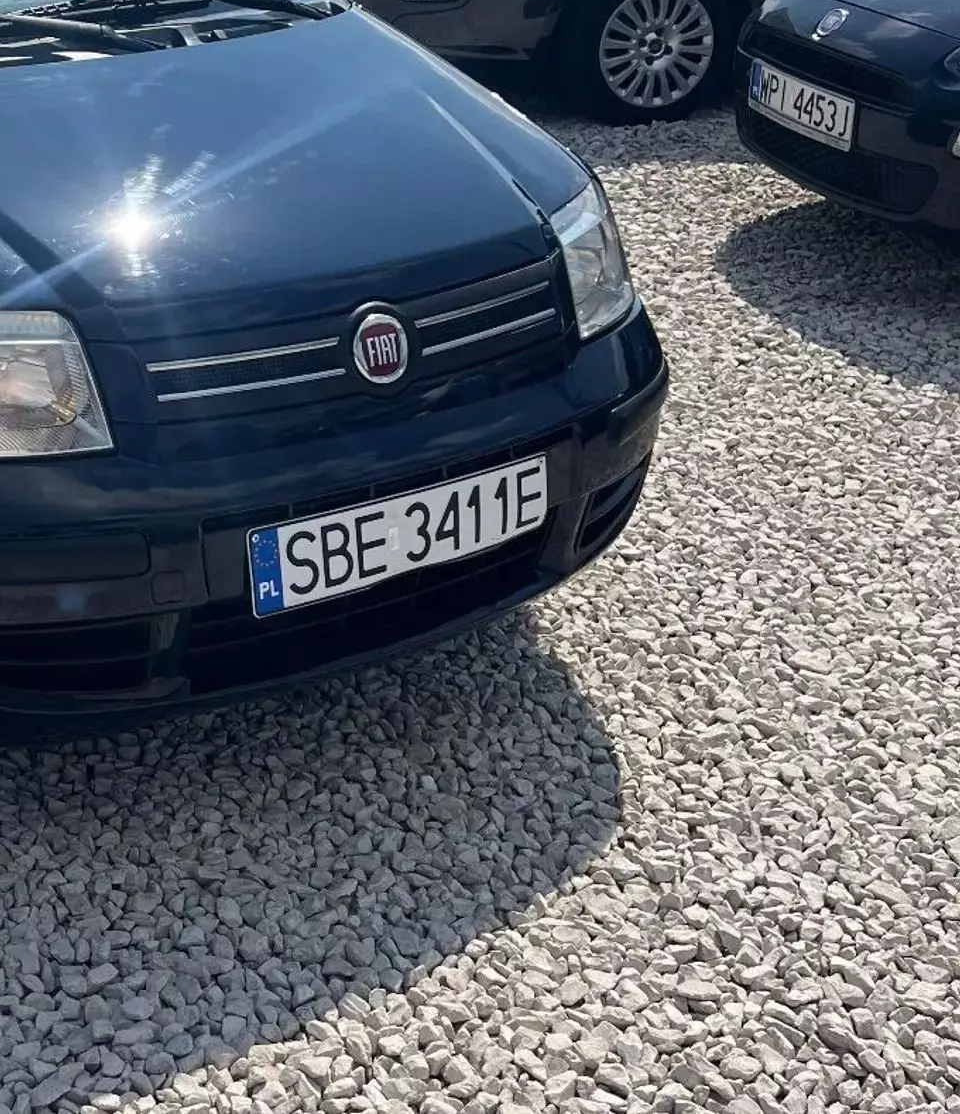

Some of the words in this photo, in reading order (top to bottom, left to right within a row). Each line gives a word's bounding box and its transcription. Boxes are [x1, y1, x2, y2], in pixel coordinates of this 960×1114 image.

[793, 87, 850, 137] 4453J
[366, 333, 398, 367] FIAT
[286, 511, 388, 595] SBE
[405, 467, 542, 563] 3411E
[259, 581, 280, 600] PL
